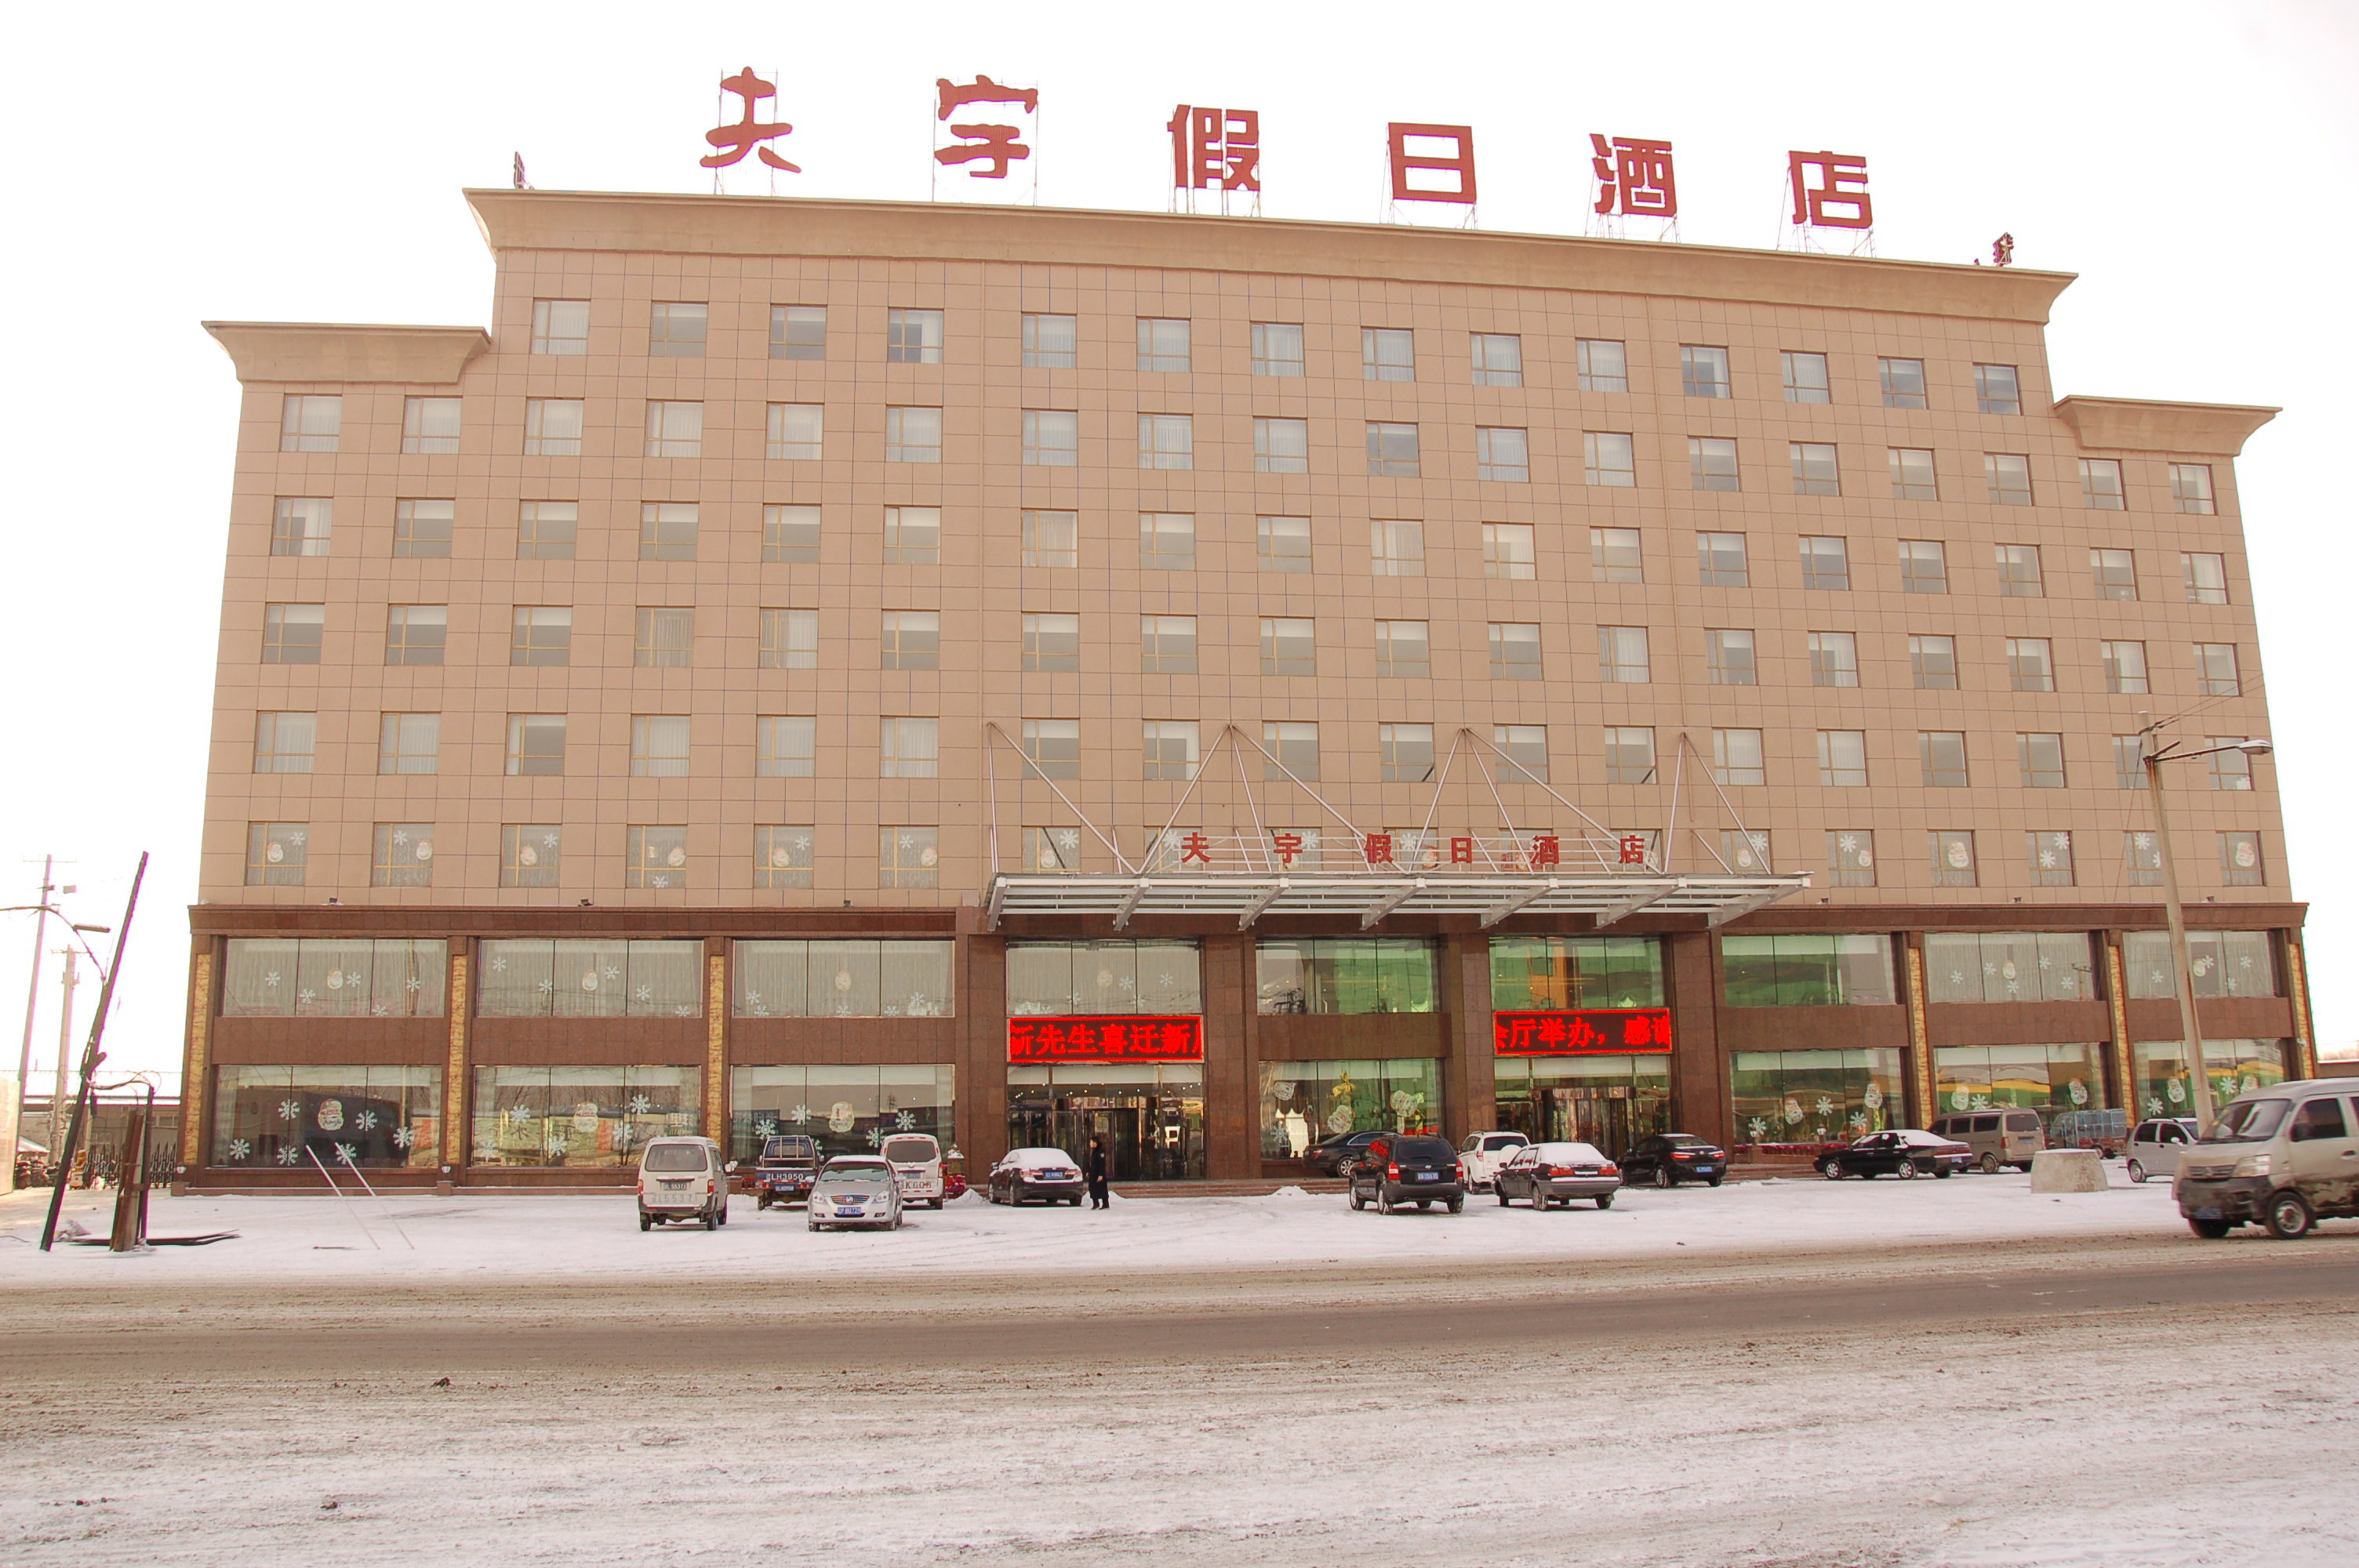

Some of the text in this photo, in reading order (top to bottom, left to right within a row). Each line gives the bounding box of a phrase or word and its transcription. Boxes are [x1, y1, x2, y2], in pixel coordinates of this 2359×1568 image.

[1181, 832, 1645, 864] 夫宇假日酒店
